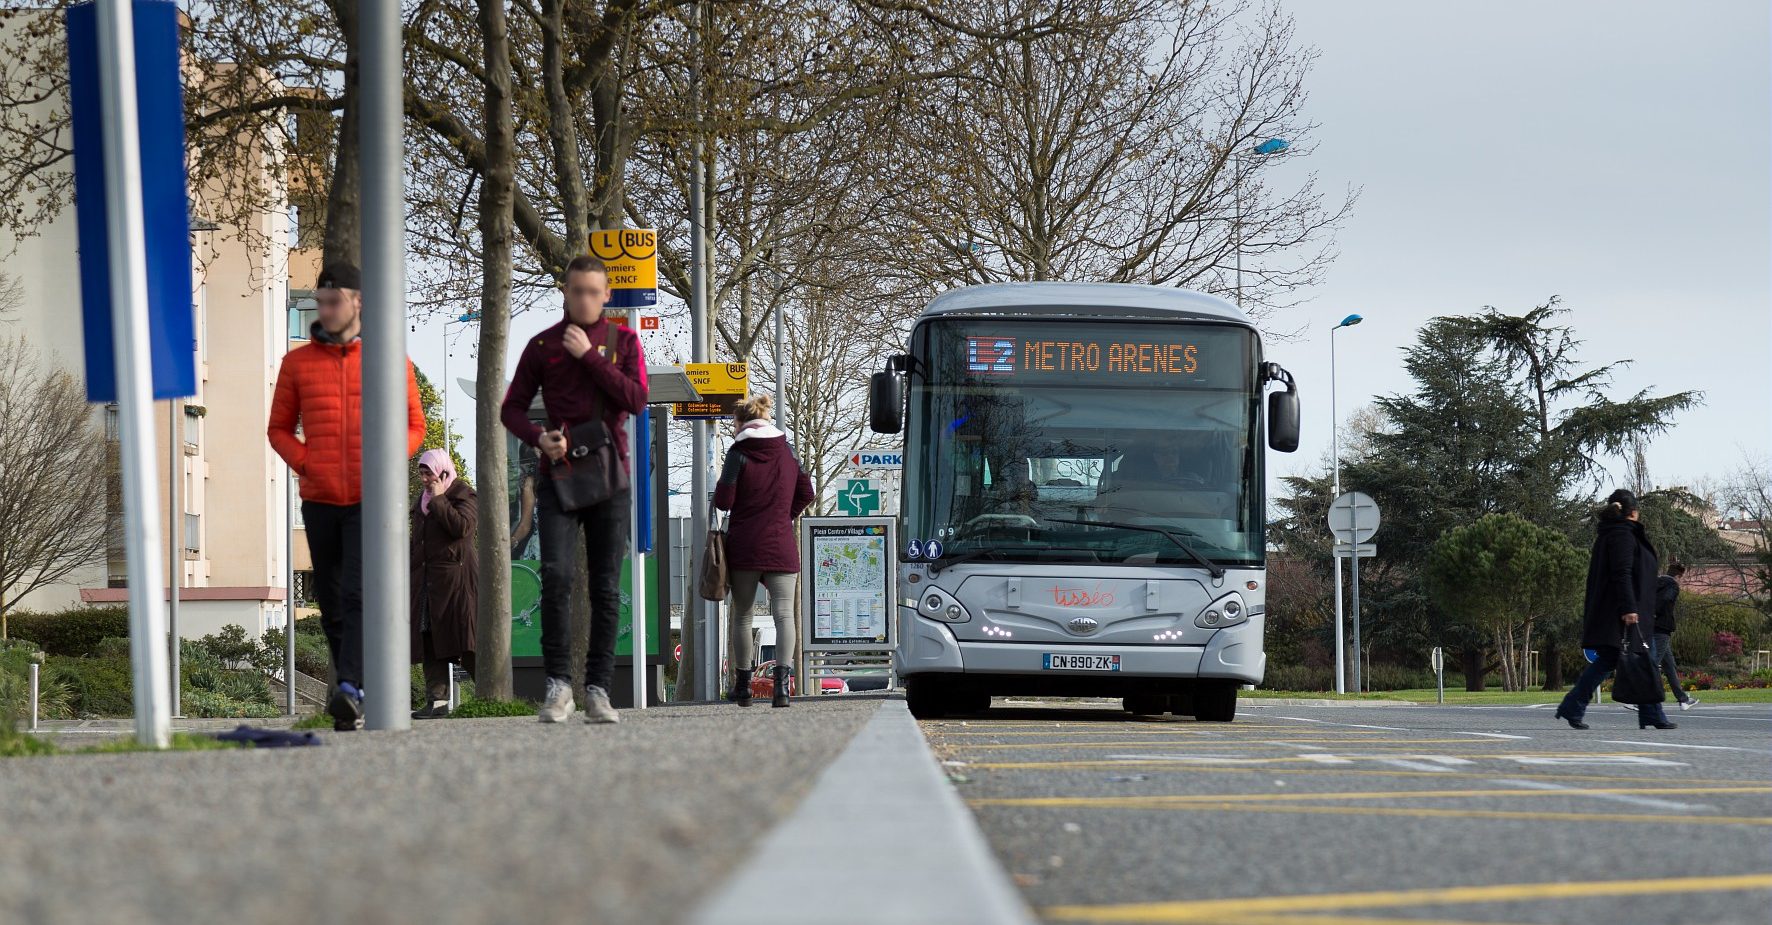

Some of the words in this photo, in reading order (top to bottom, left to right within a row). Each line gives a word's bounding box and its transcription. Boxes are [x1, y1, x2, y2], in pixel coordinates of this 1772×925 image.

[603, 233, 613, 248] L
[625, 232, 654, 247] BUS
[605, 263, 636, 272] omiers
[615, 275, 638, 284] SNCF
[644, 319, 655, 328] L2
[968, 339, 1016, 373] L2
[1024, 341, 1100, 372] METRO
[1108, 343, 1198, 373] ARENES
[685, 368, 710, 376] omiers
[729, 364, 746, 373] BUS
[693, 377, 711, 385] SNCF
[861, 454, 903, 465] PARK
